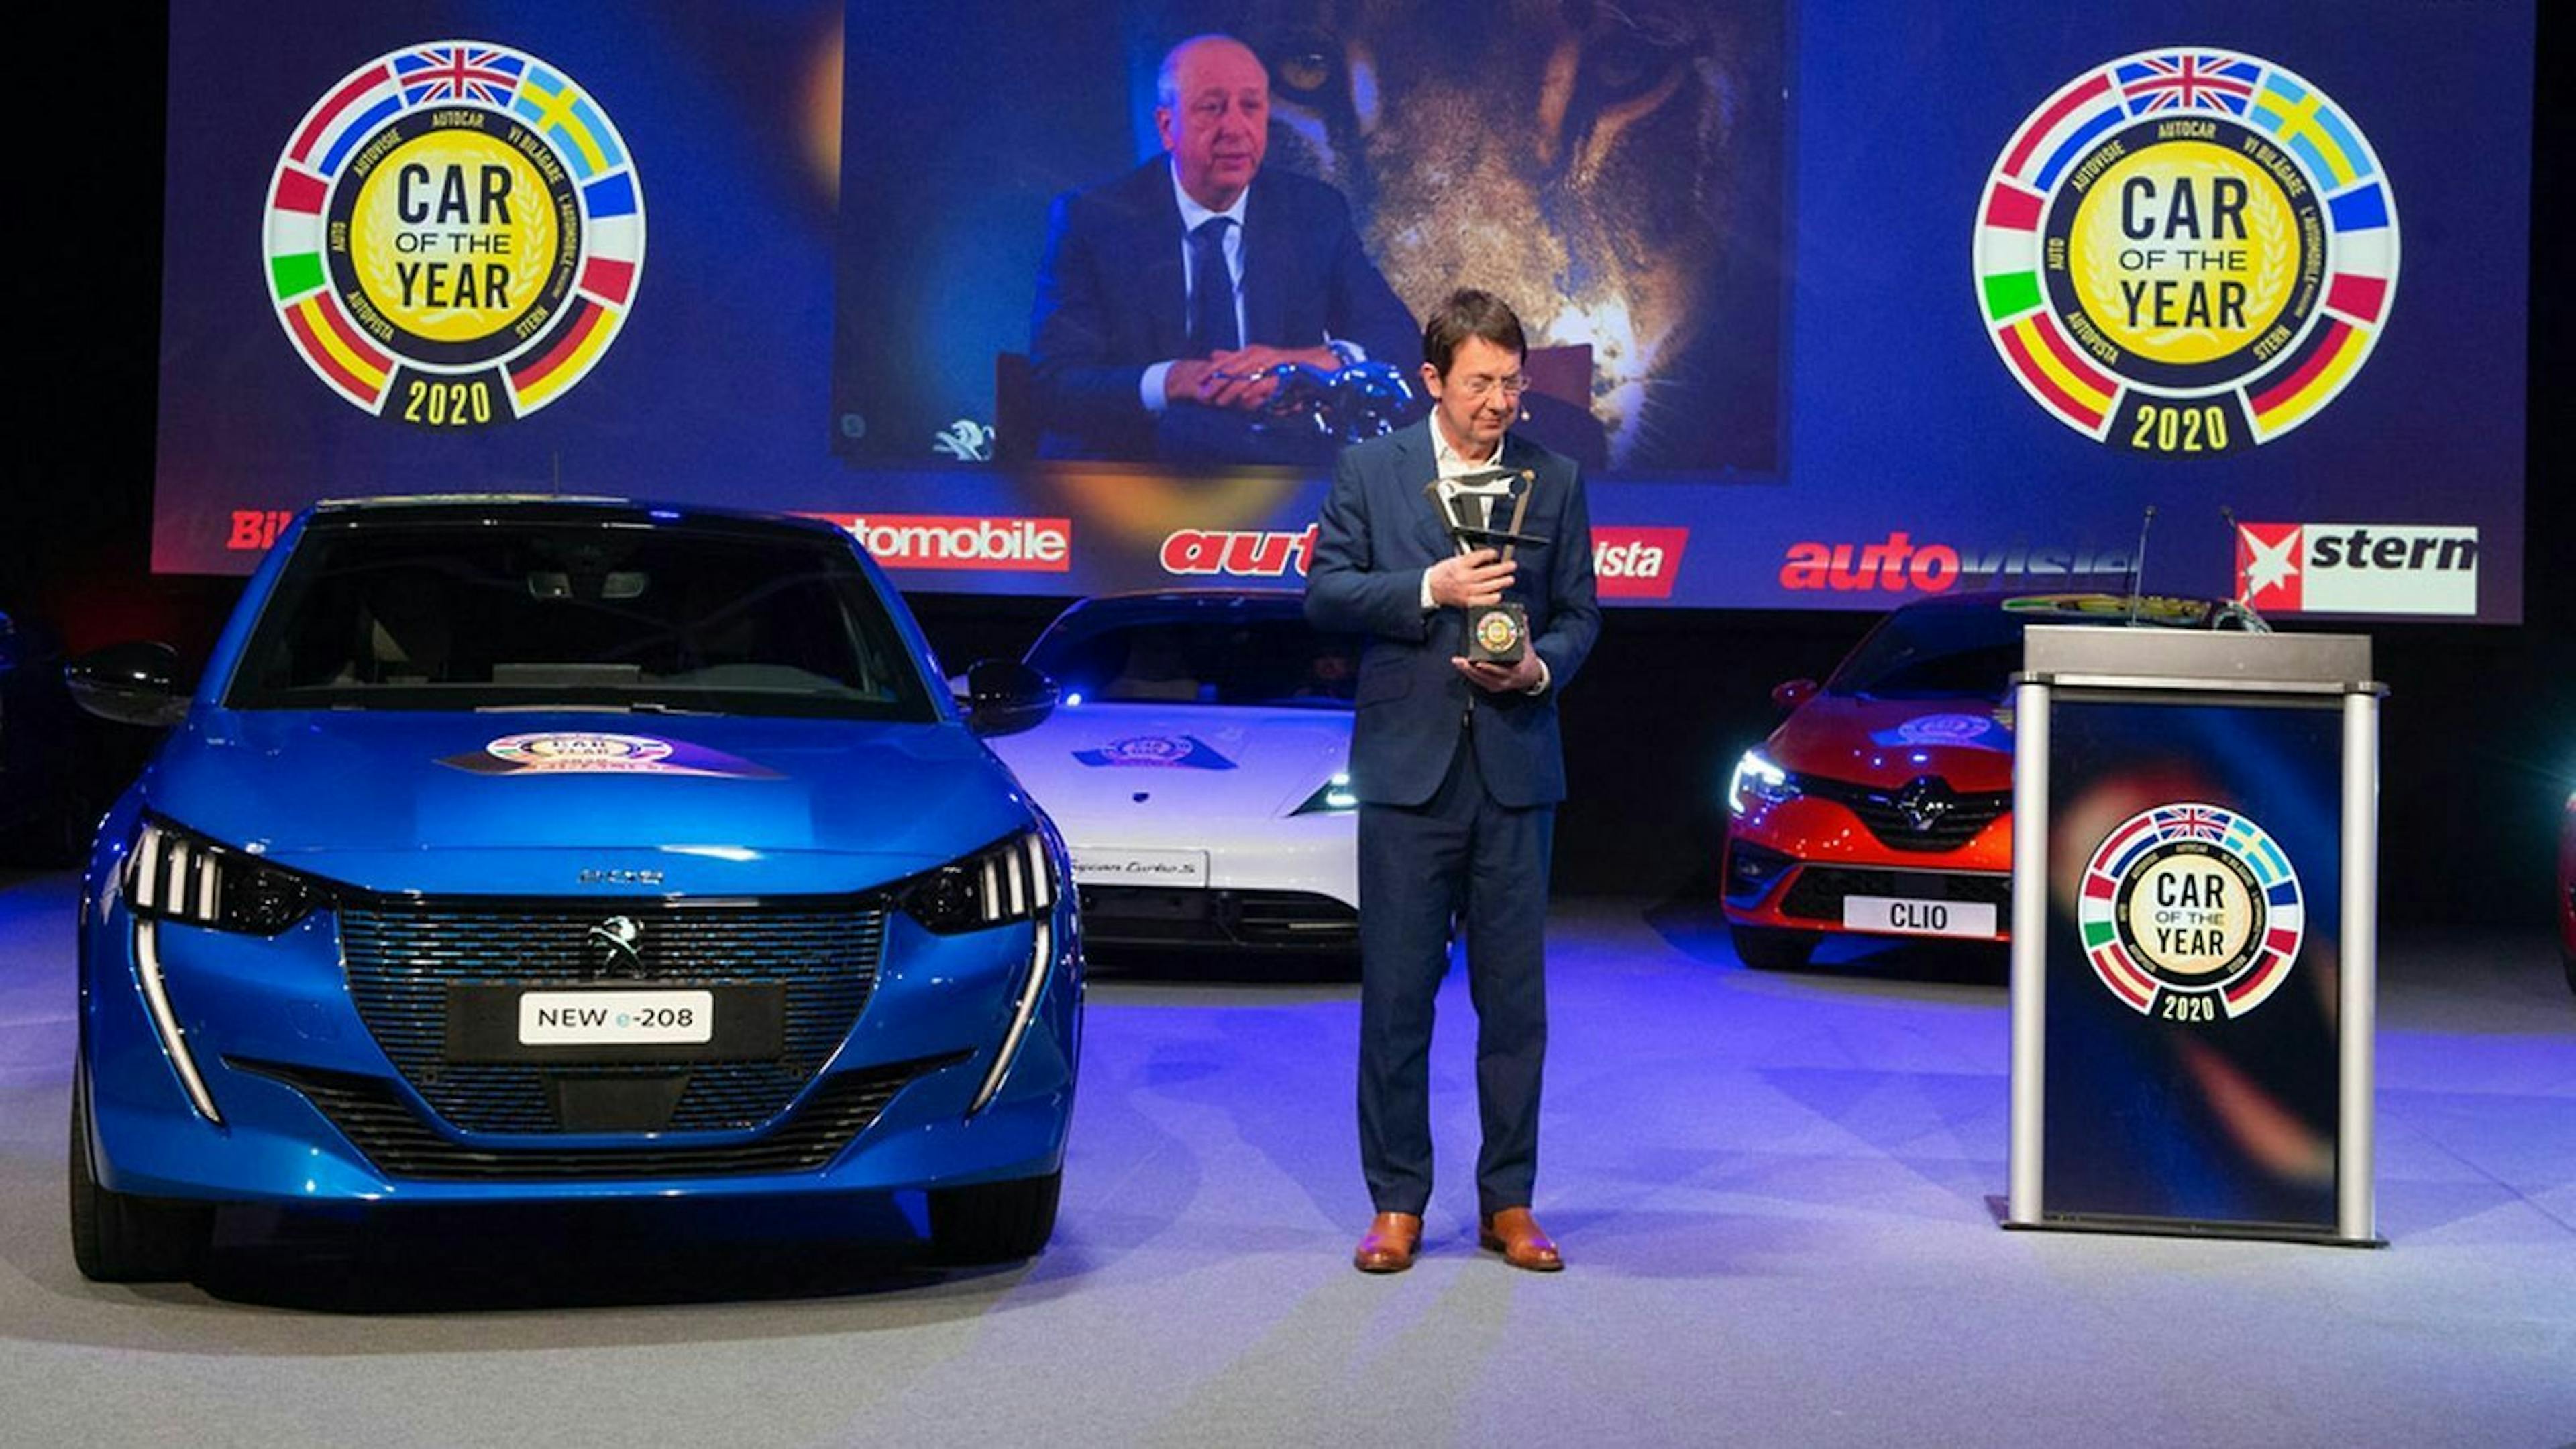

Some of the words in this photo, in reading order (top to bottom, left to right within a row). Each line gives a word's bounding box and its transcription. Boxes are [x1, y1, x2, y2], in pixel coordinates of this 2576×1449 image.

[2158, 121, 2217, 139] AUTOCAR
[2072, 139, 2126, 193] AUTOVISIE
[398, 163, 512, 224] CAR
[2122, 176, 2248, 240] CAR
[396, 232, 438, 253] OF
[448, 233, 511, 254] THE
[2120, 249, 2167, 271] OF
[2176, 250, 2247, 270] THE
[396, 262, 510, 309] YEAR
[2121, 280, 2247, 328] YEAR
[405, 379, 491, 425] 2020
[2131, 404, 2229, 451] 2020
[2311, 529, 2477, 570] stern
[2157, 873, 2224, 908] CAR
[1890, 903, 1948, 930] CLIO
[2155, 911, 2181, 924] OF
[2188, 912, 2224, 925] THE
[2157, 927, 2224, 955] YEAR
[539, 1009, 607, 1027] NEW
[616, 1009, 693, 1028] e-208
[2162, 994, 2215, 1021] 2020
